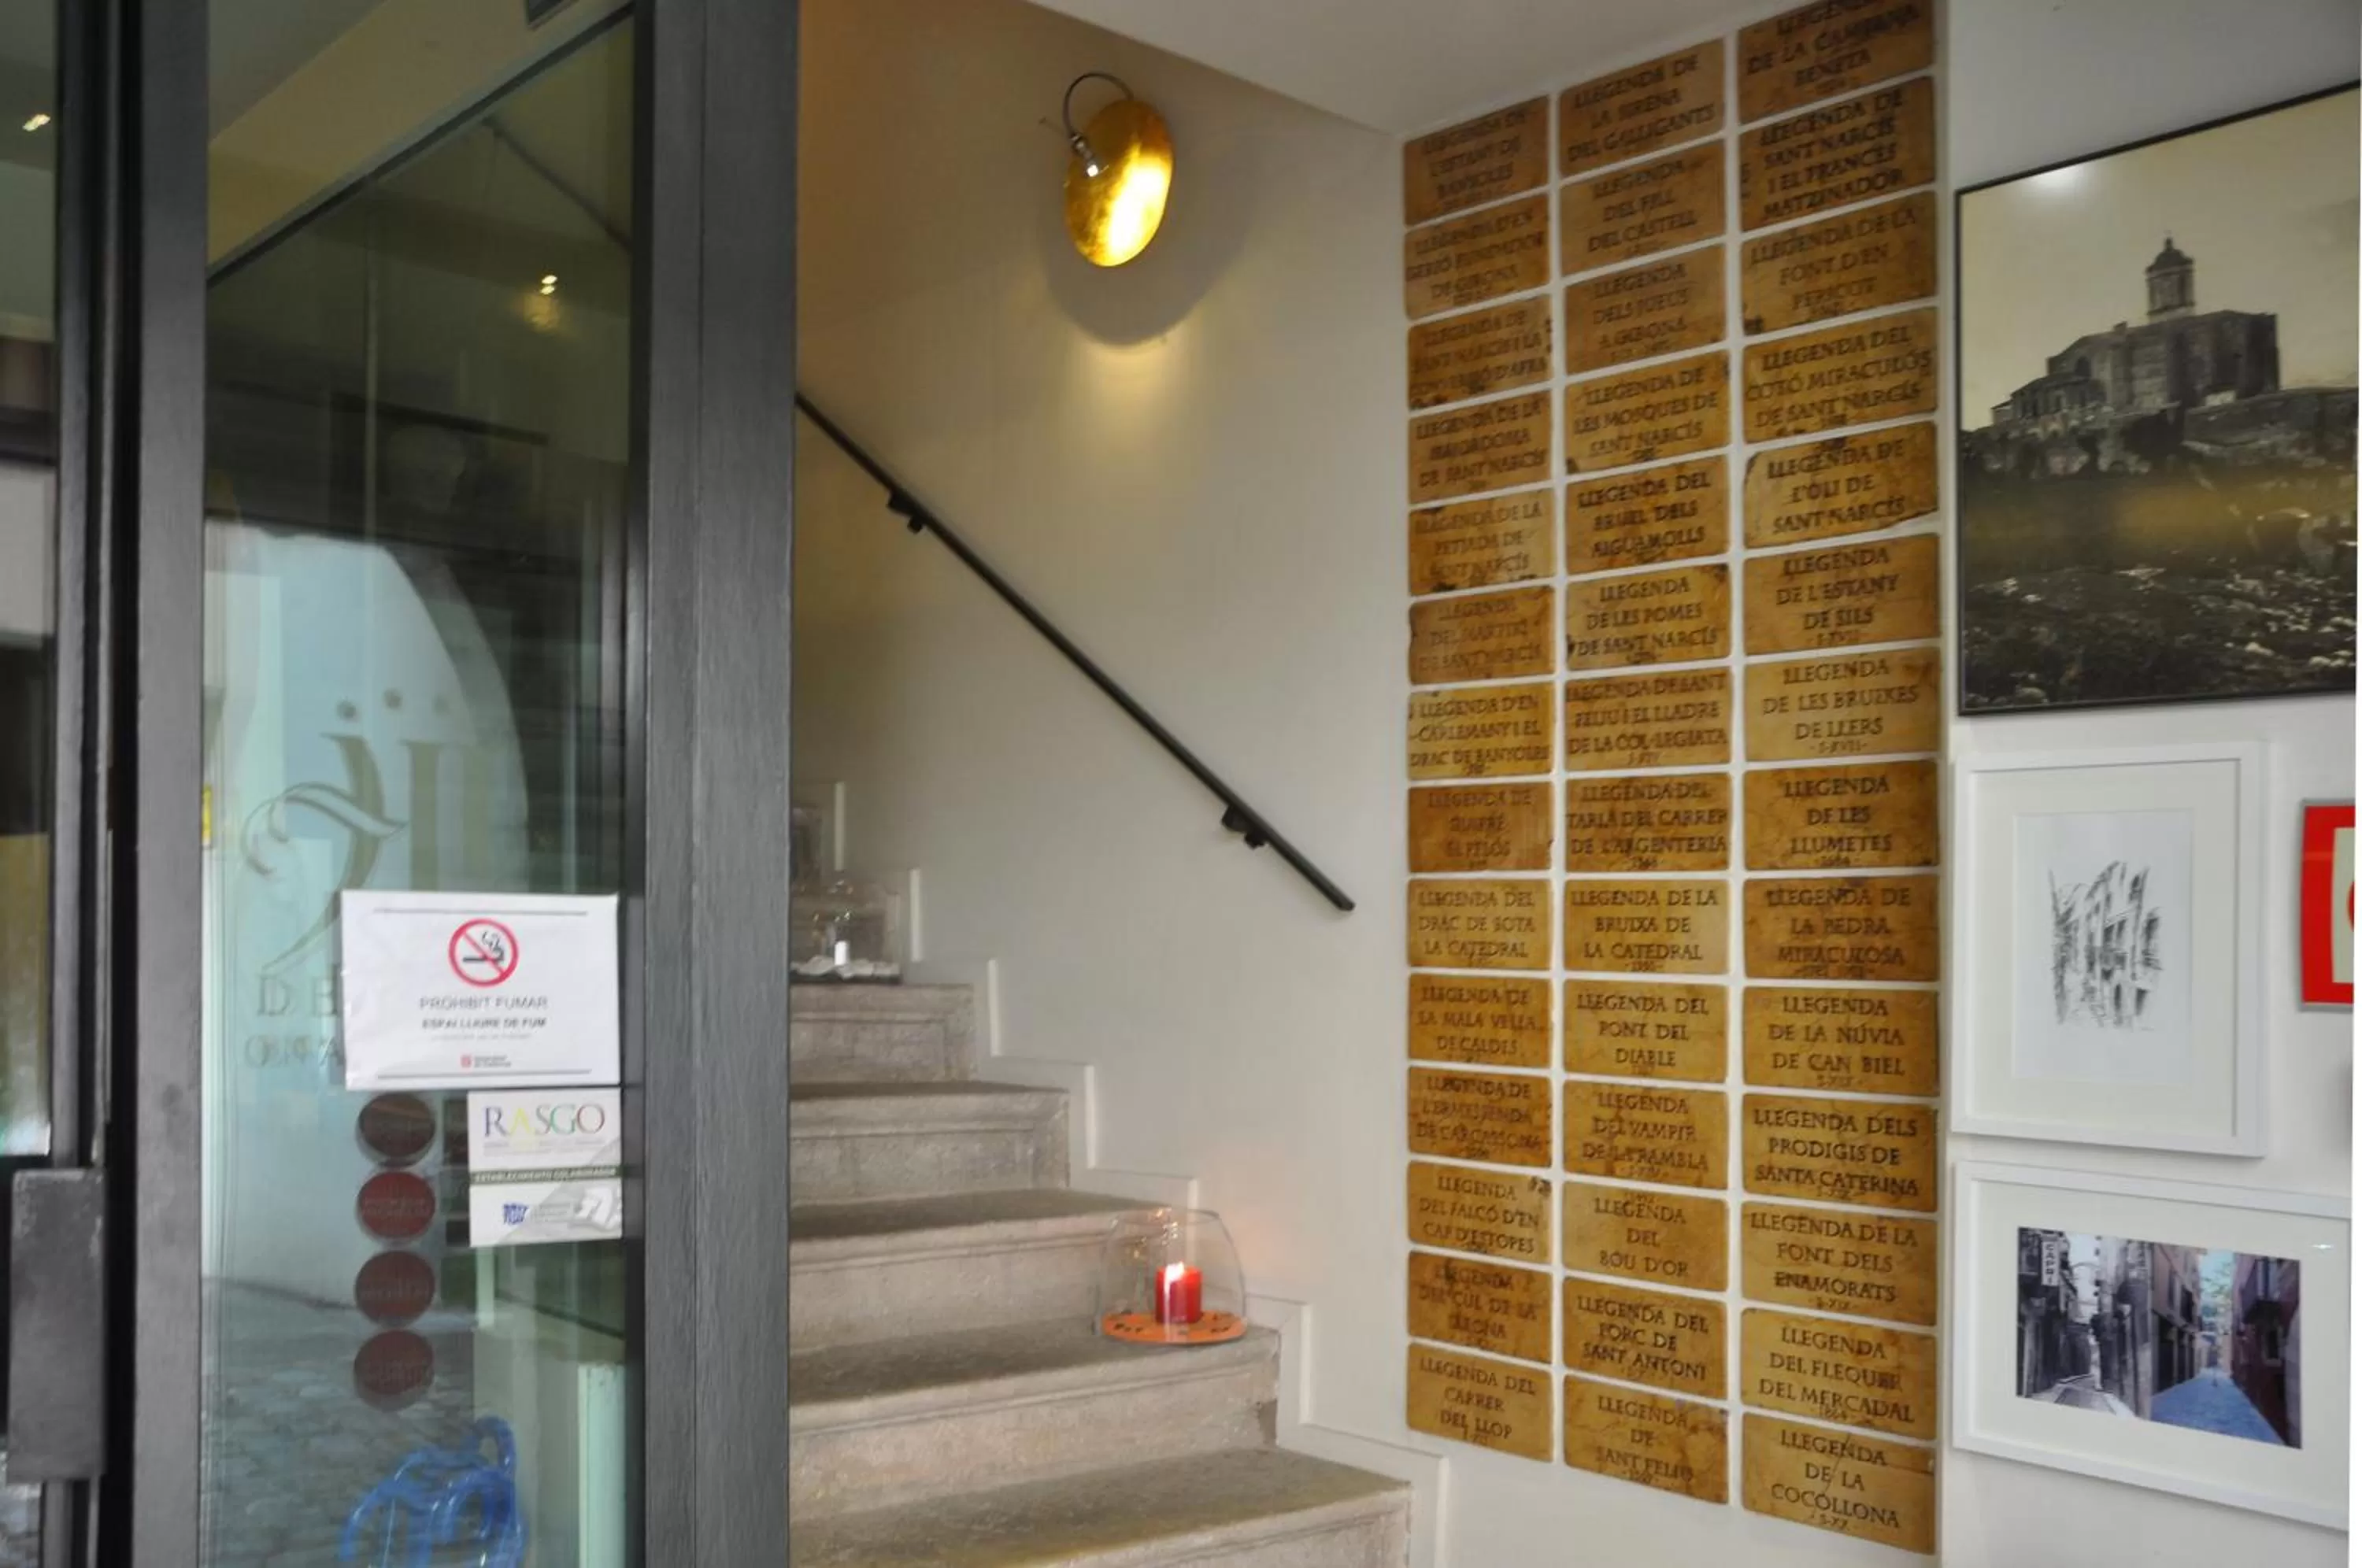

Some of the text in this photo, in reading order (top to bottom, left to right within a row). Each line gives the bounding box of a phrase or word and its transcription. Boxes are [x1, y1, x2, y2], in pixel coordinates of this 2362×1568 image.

[1672, 52, 1699, 79] DE
[1591, 108, 1610, 130] LA
[1760, 86, 1901, 148] LLEGENDA DE
[1751, 211, 1886, 267] LLEGENDA DE
[1781, 255, 1834, 285] FONT
[1763, 324, 1912, 372] LLEGENDA DEL
[1586, 365, 1704, 406] LLEGENDA DE
[1693, 390, 1718, 412] DE
[1756, 396, 1835, 427] DE SANT
[1768, 438, 1903, 480] LLEGENDA DE
[1579, 469, 1711, 509] LLEGENDA DEL
[1845, 472, 1874, 494] DE
[1773, 509, 1821, 534] SANT
[1783, 545, 1888, 576] LLEGENDA
[1599, 575, 1690, 603] LLEGENDA
[1776, 586, 1801, 605] DE
[1586, 601, 1702, 629] DE LES POMES
[1804, 605, 1872, 630] DE SILS
[1577, 638, 1598, 656] DE
[1783, 658, 1890, 685] LLEGENDA
[1763, 684, 1919, 715] DE LES BRUIXES
[1794, 716, 1884, 741] DE LLERS
[1568, 735, 1612, 754] DE LA
[1785, 775, 1888, 798] LLEGENDA
[1807, 805, 1869, 825] DE LES
[1791, 834, 1890, 853] LLUMETES
[1420, 891, 1535, 906] LLEGENDA DEL
[1572, 889, 1718, 907] LLEGENDA DE LA
[1767, 886, 1911, 907] LLEGENDA DE
[1419, 915, 1457, 930] DRAC
[1466, 916, 1486, 931] DE
[1594, 915, 1690, 933] BRUIXA DE
[1790, 917, 1890, 934] LA PEDRA
[1423, 940, 1528, 957] LA CATEDRAL
[1583, 942, 1704, 960] LA CATEDRAL
[1778, 946, 1905, 966] MIRACULOSA
[419, 995, 549, 1010] PROHIBIT FUMAR
[1421, 985, 1528, 1006] LLEGENDA DE
[1575, 993, 1710, 1015] LLEGENDA DEL
[1783, 997, 1888, 1015] LLEGENDA
[1436, 1035, 1455, 1050] DE
[1599, 1020, 1690, 1041] PONT DEL
[1768, 1023, 1905, 1047] DE LA NÚVIA
[1615, 1047, 1675, 1067] DIABLE
[1771, 1051, 1905, 1077] DE CAN BIEL
[1597, 1091, 1688, 1115] LLEGENDA
[483, 1104, 605, 1137] RASGO
[1593, 1117, 1624, 1136] DEL
[1753, 1108, 1918, 1137] LLEGENDA DELS
[1583, 1141, 1709, 1171] DE RAMBLA
[1769, 1137, 1899, 1166] PRODIGIS DE
[1438, 1175, 1516, 1201] LLEGENDA
[1754, 1163, 1814, 1186] SANTA
[1820, 1170, 1919, 1197] CATERINA
[1594, 1196, 1686, 1225] LLEGENDA
[1626, 1226, 1660, 1247] DEL
[1750, 1212, 1918, 1247] LLEGENDA DE LA
[1599, 1249, 1635, 1270] BOU
[1775, 1242, 1892, 1274] FONT DELS
[1774, 1270, 1897, 1304] ENAMORATS
[1577, 1293, 1710, 1334] LLEGENDA DEL
[1653, 1331, 1677, 1352] DE
[1781, 1326, 1886, 1359] LLEGENDA
[1582, 1341, 1626, 1366] SANT
[1635, 1351, 1706, 1381] ANTONI
[1770, 1352, 1805, 1375] DEL
[1420, 1355, 1537, 1396] LLEGENDA DEL
[1445, 1385, 1505, 1413] CARRER
[1598, 1393, 1688, 1430] LLEGENDA
[1759, 1377, 1796, 1401] DEL
[1801, 1385, 1915, 1424] MERCADAL
[1441, 1408, 1467, 1429] DEL
[1475, 1416, 1512, 1440] LLOP
[1631, 1427, 1653, 1447] DE
[1595, 1444, 1637, 1470] SANT
[1780, 1429, 1886, 1467] LLEGENDA
[1805, 1462, 1864, 1492] DE LA
[1772, 1481, 1900, 1529] COCOLLONA
